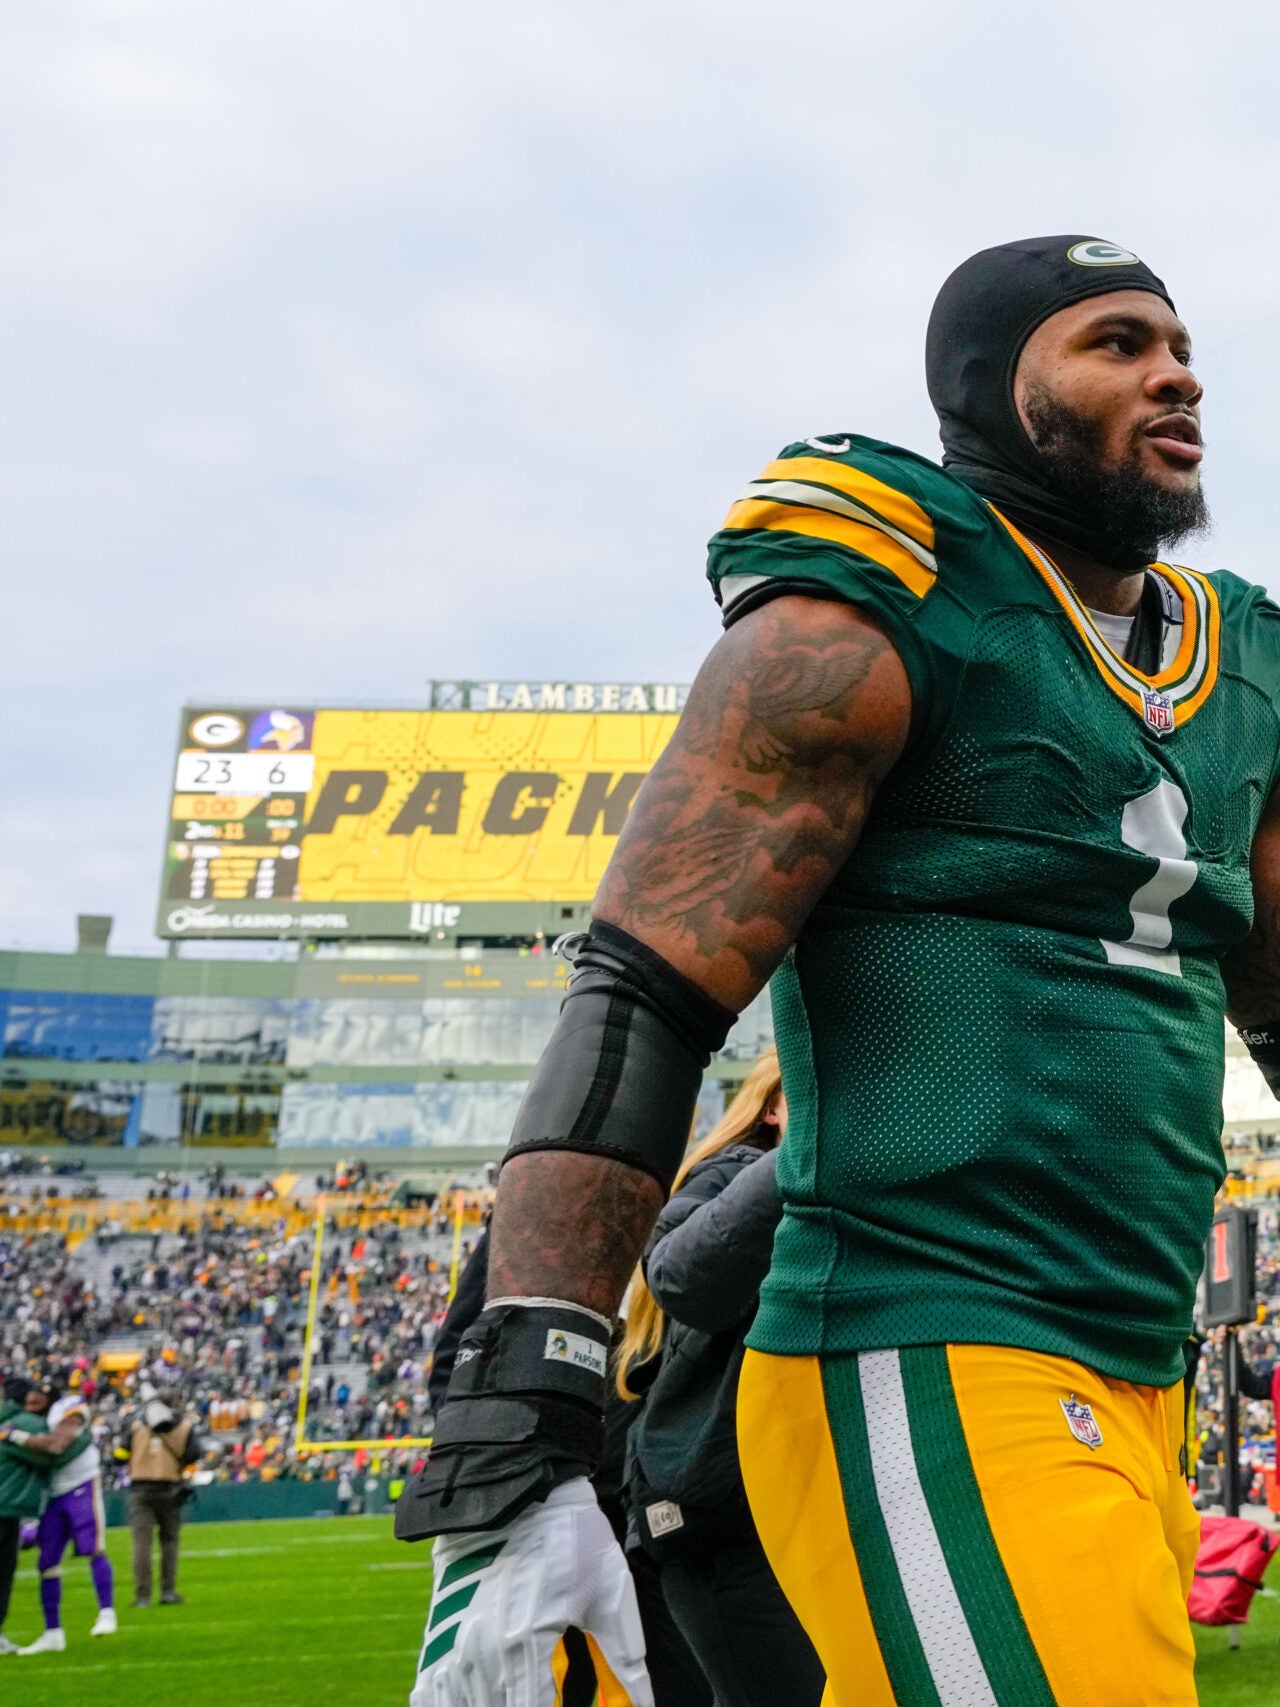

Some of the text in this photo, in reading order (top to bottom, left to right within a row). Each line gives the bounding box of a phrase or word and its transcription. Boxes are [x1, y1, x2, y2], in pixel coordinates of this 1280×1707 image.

[485, 682, 677, 712] LAMBEAU
[1149, 705, 1171, 728] NFL
[193, 759, 286, 785] 23 6
[1100, 778, 1198, 978] 1
[409, 902, 461, 933] Lite
[1213, 1221, 1229, 1284] 1
[1071, 1418, 1098, 1438] NFL
